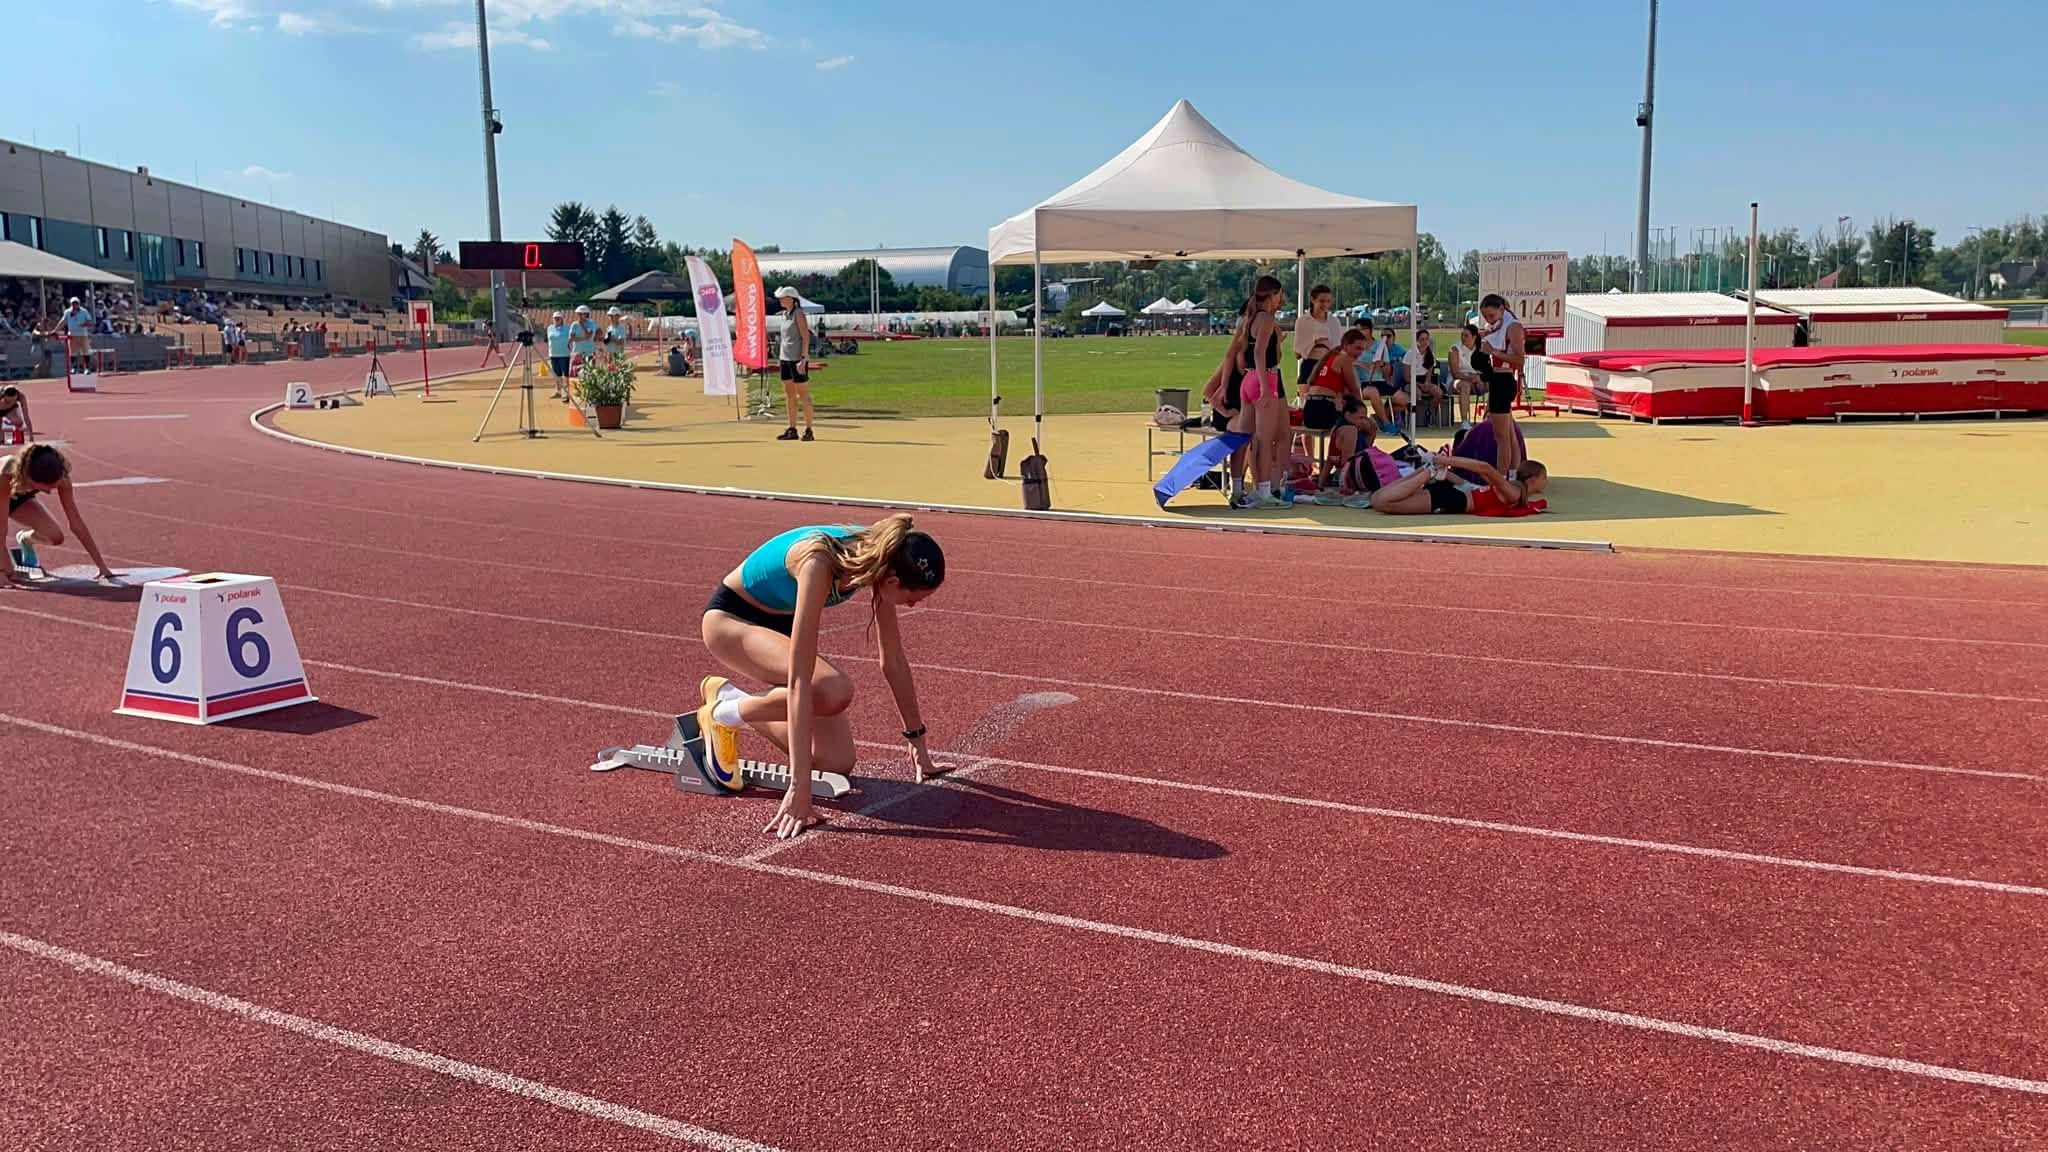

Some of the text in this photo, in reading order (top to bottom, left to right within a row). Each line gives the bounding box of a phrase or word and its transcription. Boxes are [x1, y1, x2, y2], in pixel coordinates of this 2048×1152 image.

[1545, 263, 1553, 282] 1
[1902, 368, 1938, 377] polanik
[295, 387, 307, 403] 2
[227, 587, 261, 602] polanik
[151, 611, 183, 684] 6
[226, 607, 271, 678] 6
